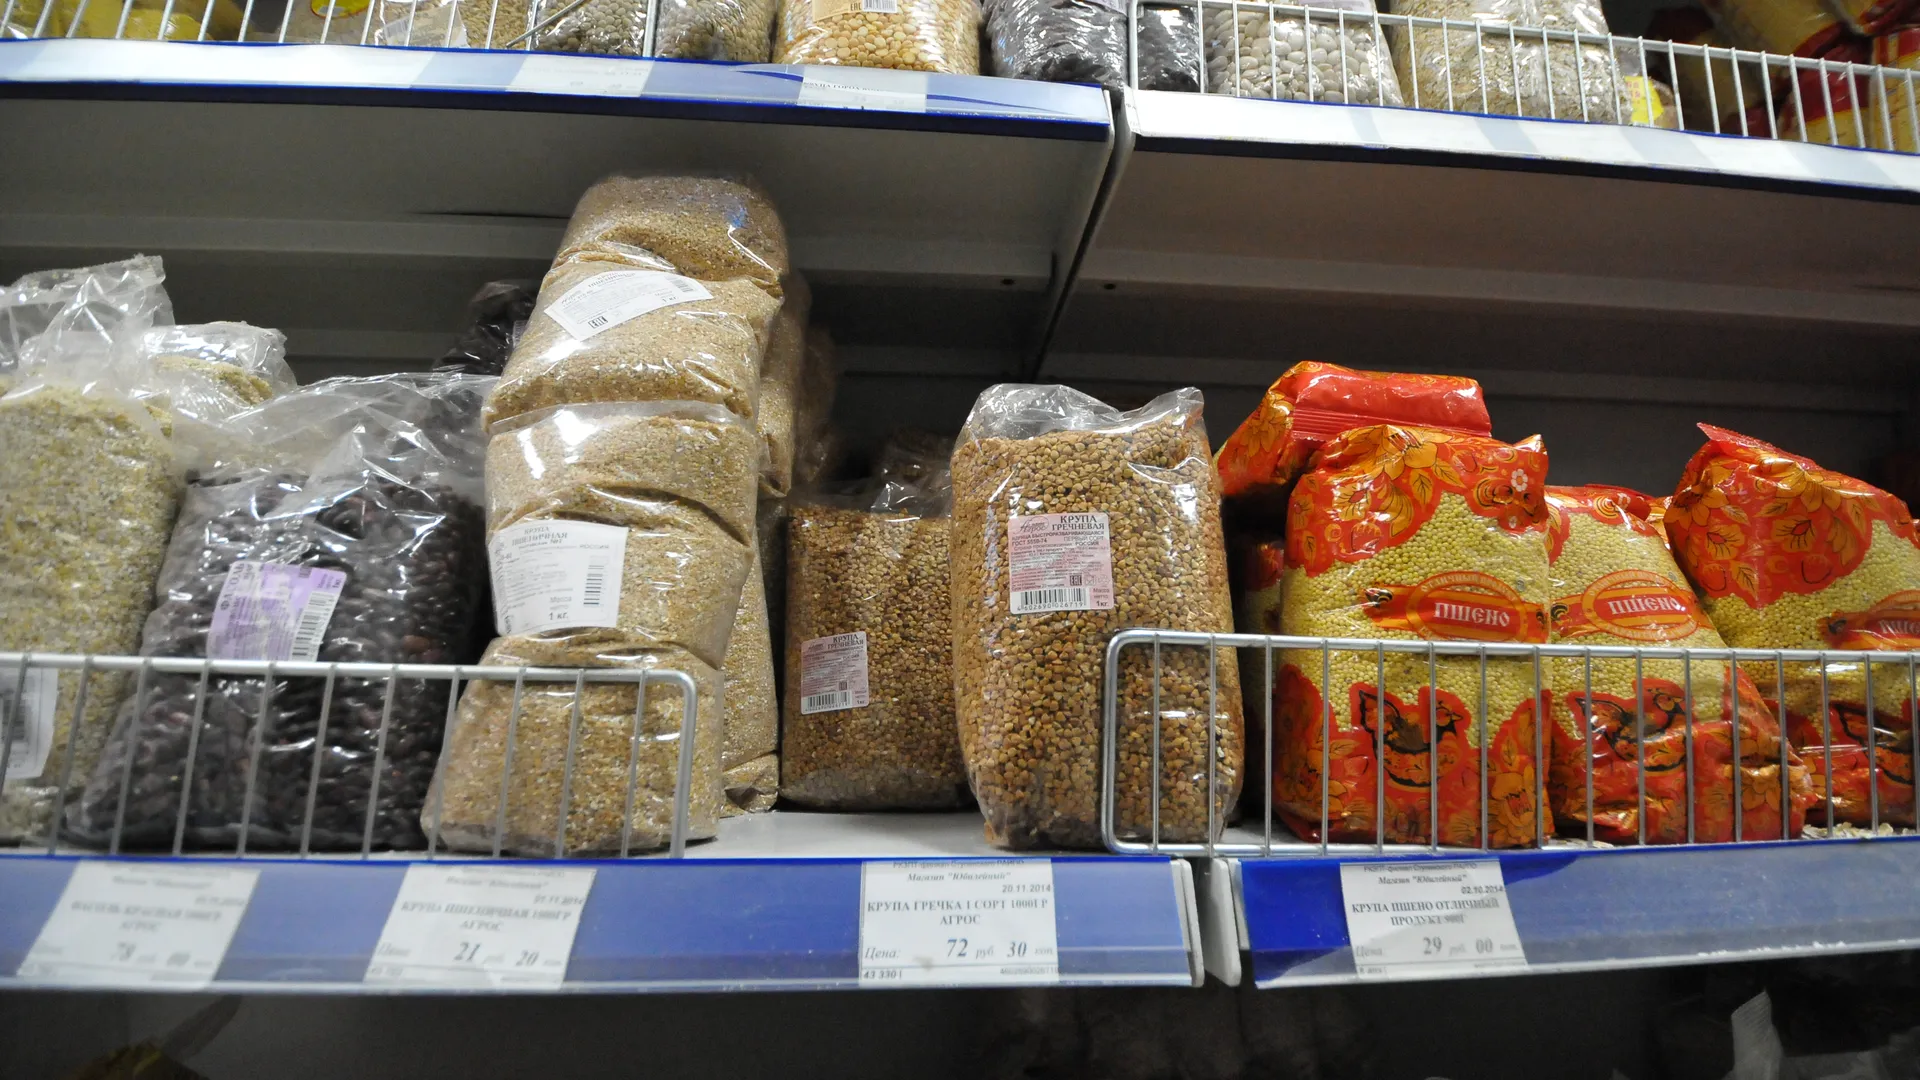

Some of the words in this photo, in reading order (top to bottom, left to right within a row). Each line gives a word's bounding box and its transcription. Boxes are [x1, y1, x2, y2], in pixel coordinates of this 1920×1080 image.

[1060, 515, 1097, 523] КРУПА
[1608, 597, 1686, 615] ПШЕНО
[1434, 602, 1510, 627] ПШЕНО
[1002, 884, 1051, 893] 20.11.2014
[867, 902, 910, 912] КРУПА
[914, 901, 961, 911] ГРЕЧКА
[974, 900, 1006, 910] СОРТ
[1352, 903, 1390, 913] КРУПА
[1391, 901, 1433, 912] ПШЕНО
[1435, 898, 1500, 911] ОТЛИЧНЫЙ
[939, 915, 981, 925] АГРОС
[1391, 916, 1442, 926] ПРОДУКТ
[947, 938, 969, 957] 72
[1006, 942, 1027, 957] 30
[1423, 936, 1442, 955] 29
[1475, 937, 1493, 954] 00
[453, 941, 481, 962] 21
[516, 950, 539, 967] 20
